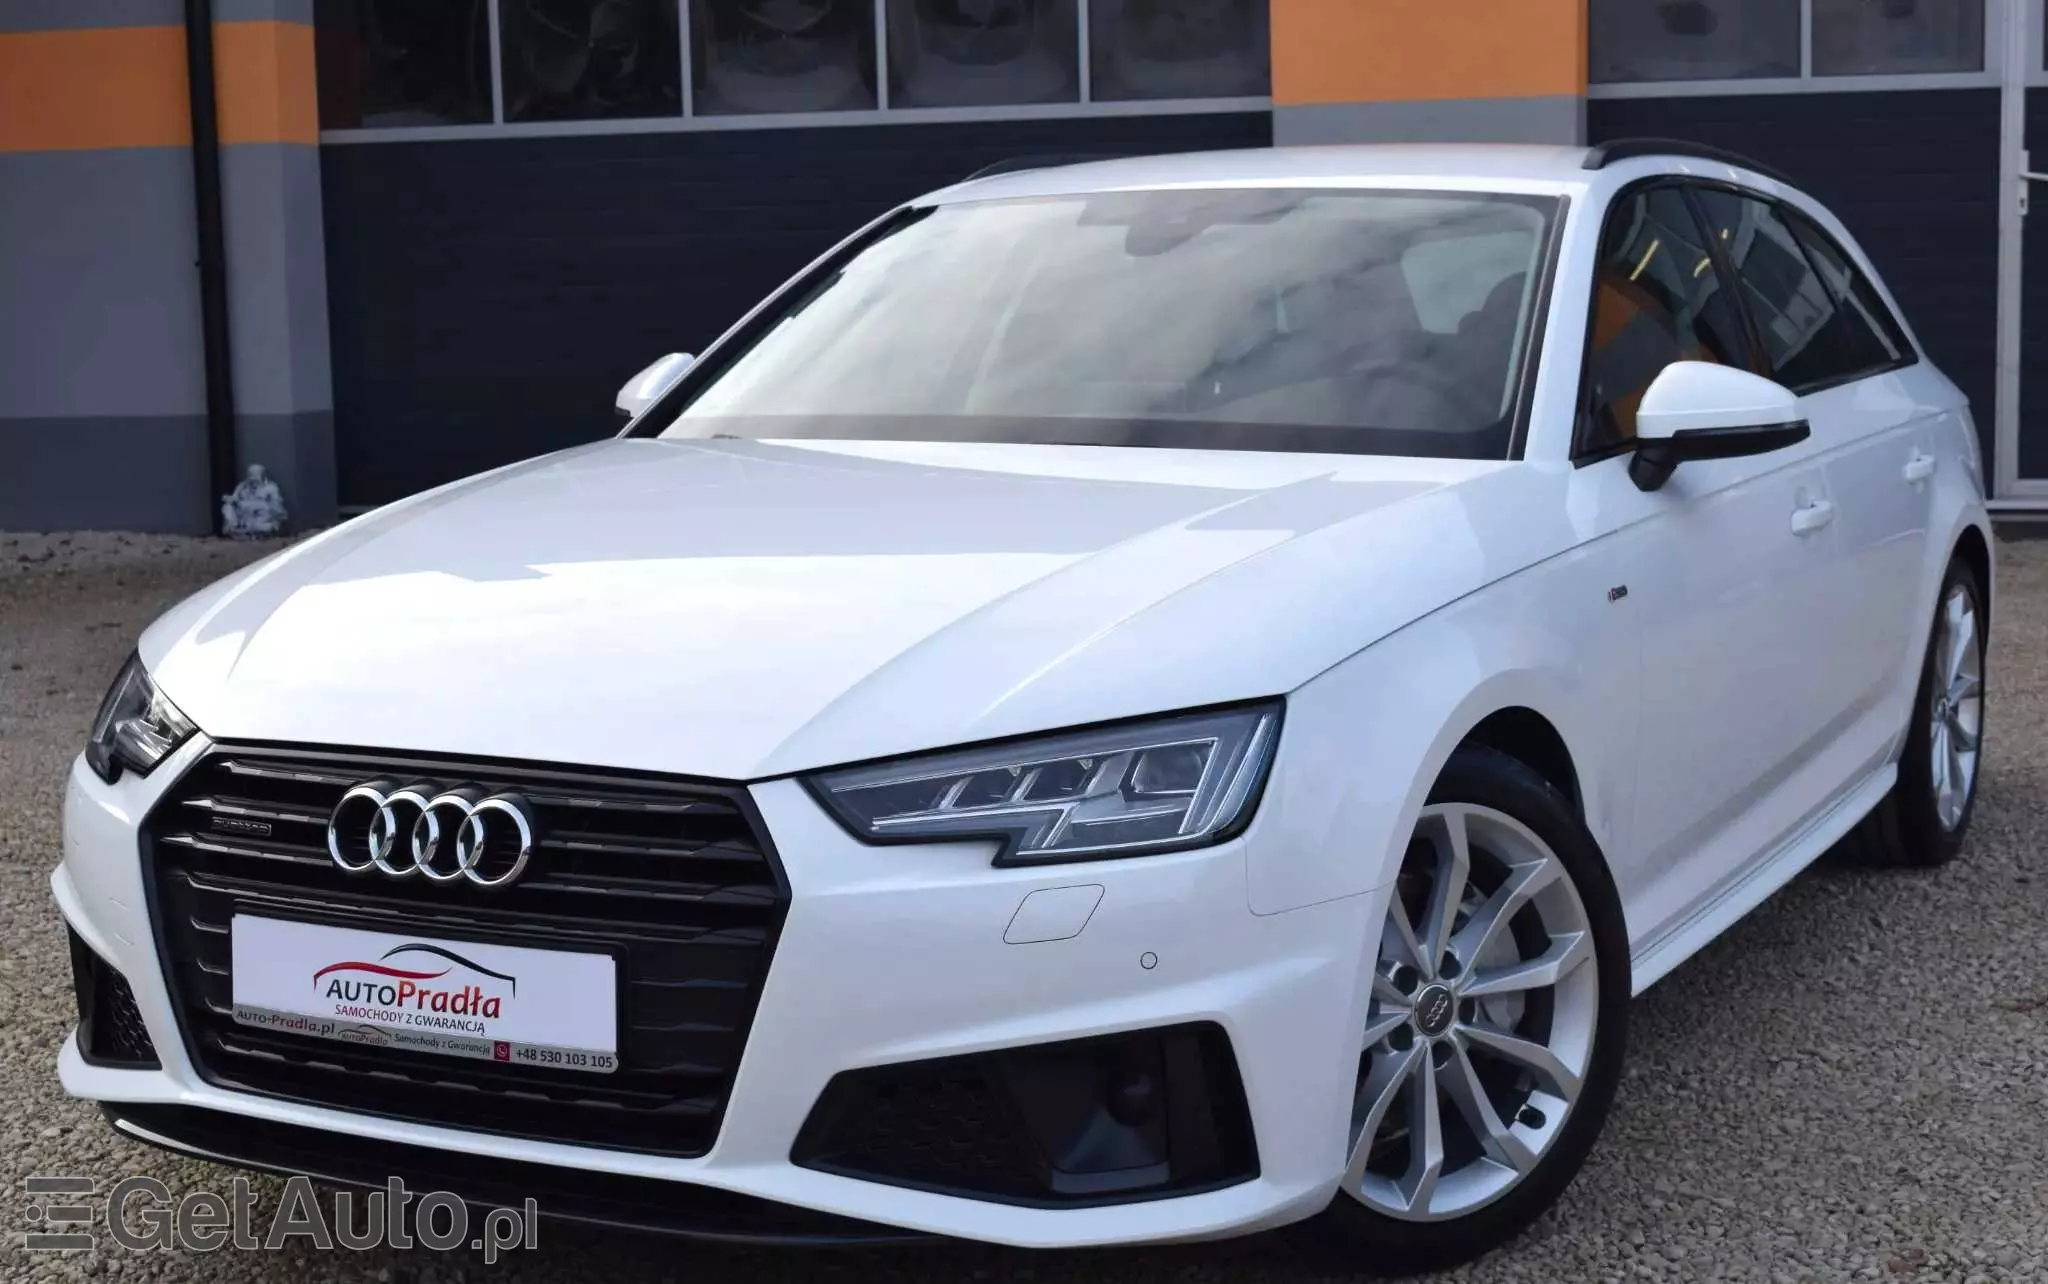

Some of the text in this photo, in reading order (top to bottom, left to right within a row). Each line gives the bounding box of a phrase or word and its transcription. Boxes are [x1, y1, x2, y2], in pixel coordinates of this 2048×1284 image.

[326, 979, 501, 1019] AUTOPradła
[335, 1004, 486, 1037] SAMOCHODY Z GWARANCJĄ
[394, 1032, 440, 1049] Samochody
[515, 1048, 537, 1061] +48
[540, 1050, 562, 1063] 530
[566, 1053, 587, 1066] 103
[591, 1055, 613, 1068] 105
